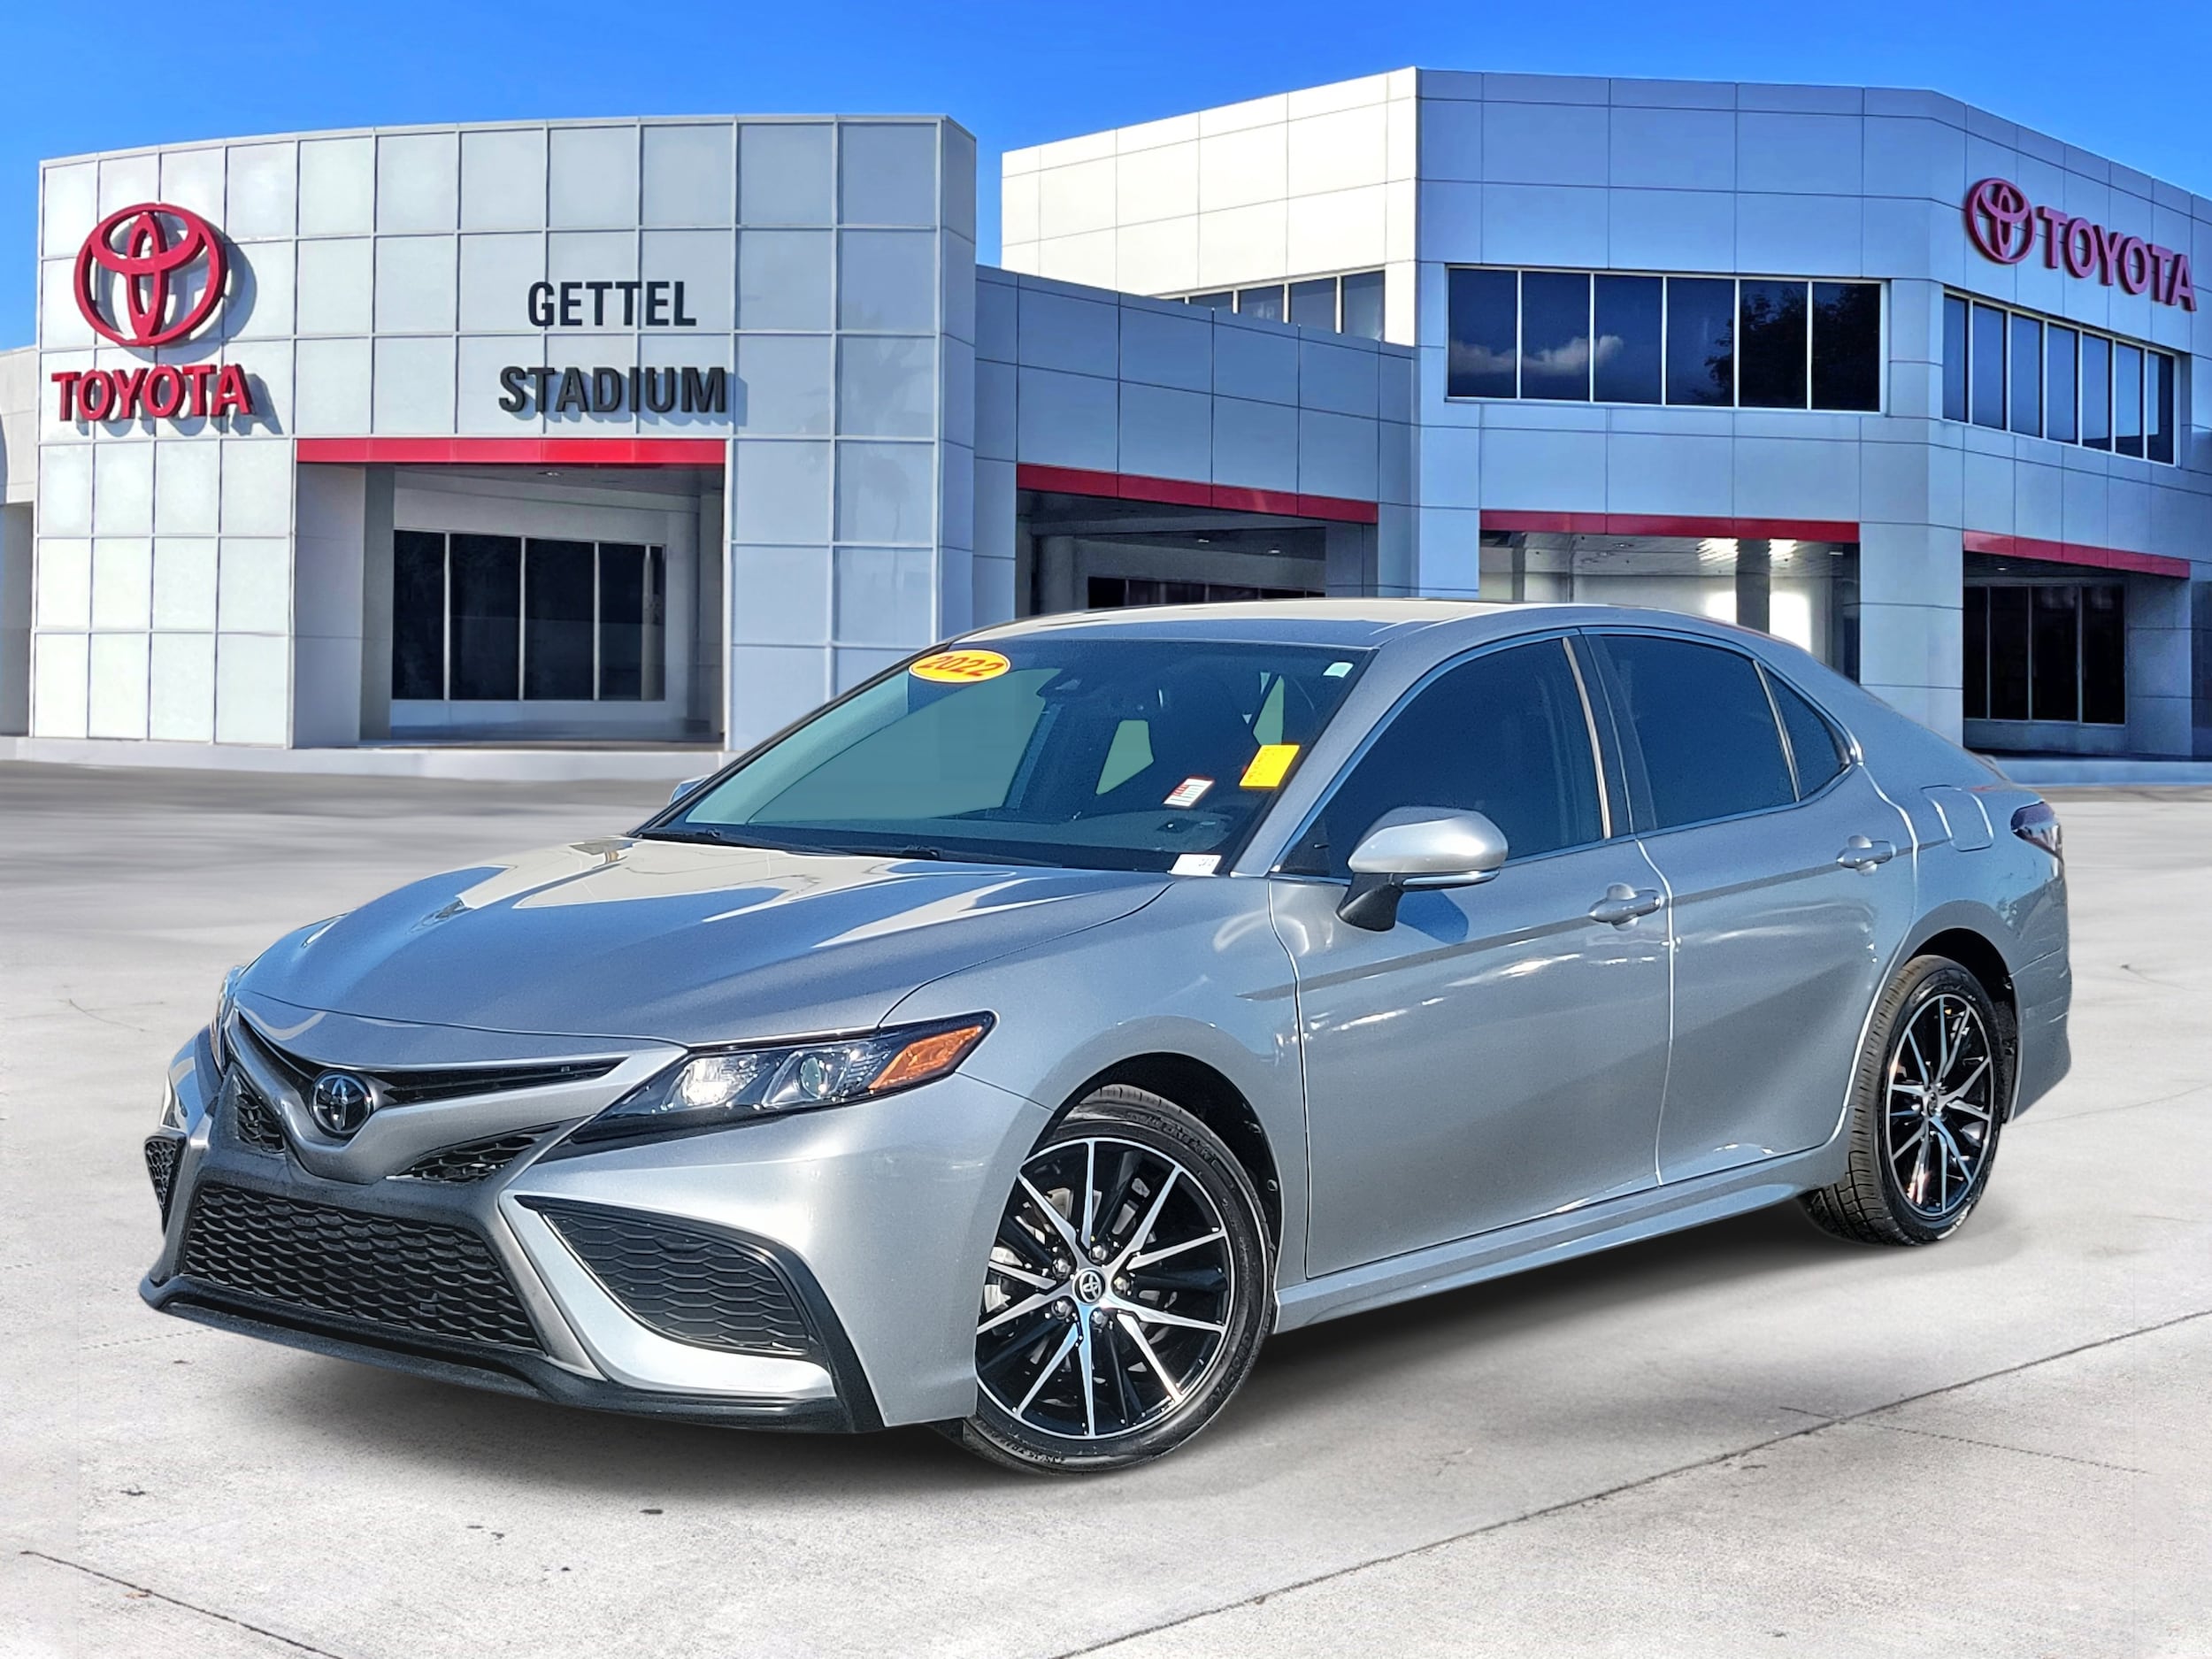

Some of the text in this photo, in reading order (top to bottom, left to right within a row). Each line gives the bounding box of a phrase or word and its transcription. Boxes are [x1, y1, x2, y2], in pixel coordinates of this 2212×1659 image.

[2037, 205, 2197, 311] TOYOTA
[528, 281, 696, 326] GETTEL
[51, 364, 255, 421] TOYOTA
[498, 366, 726, 412] STADIUM
[916, 656, 1004, 677] 2022
